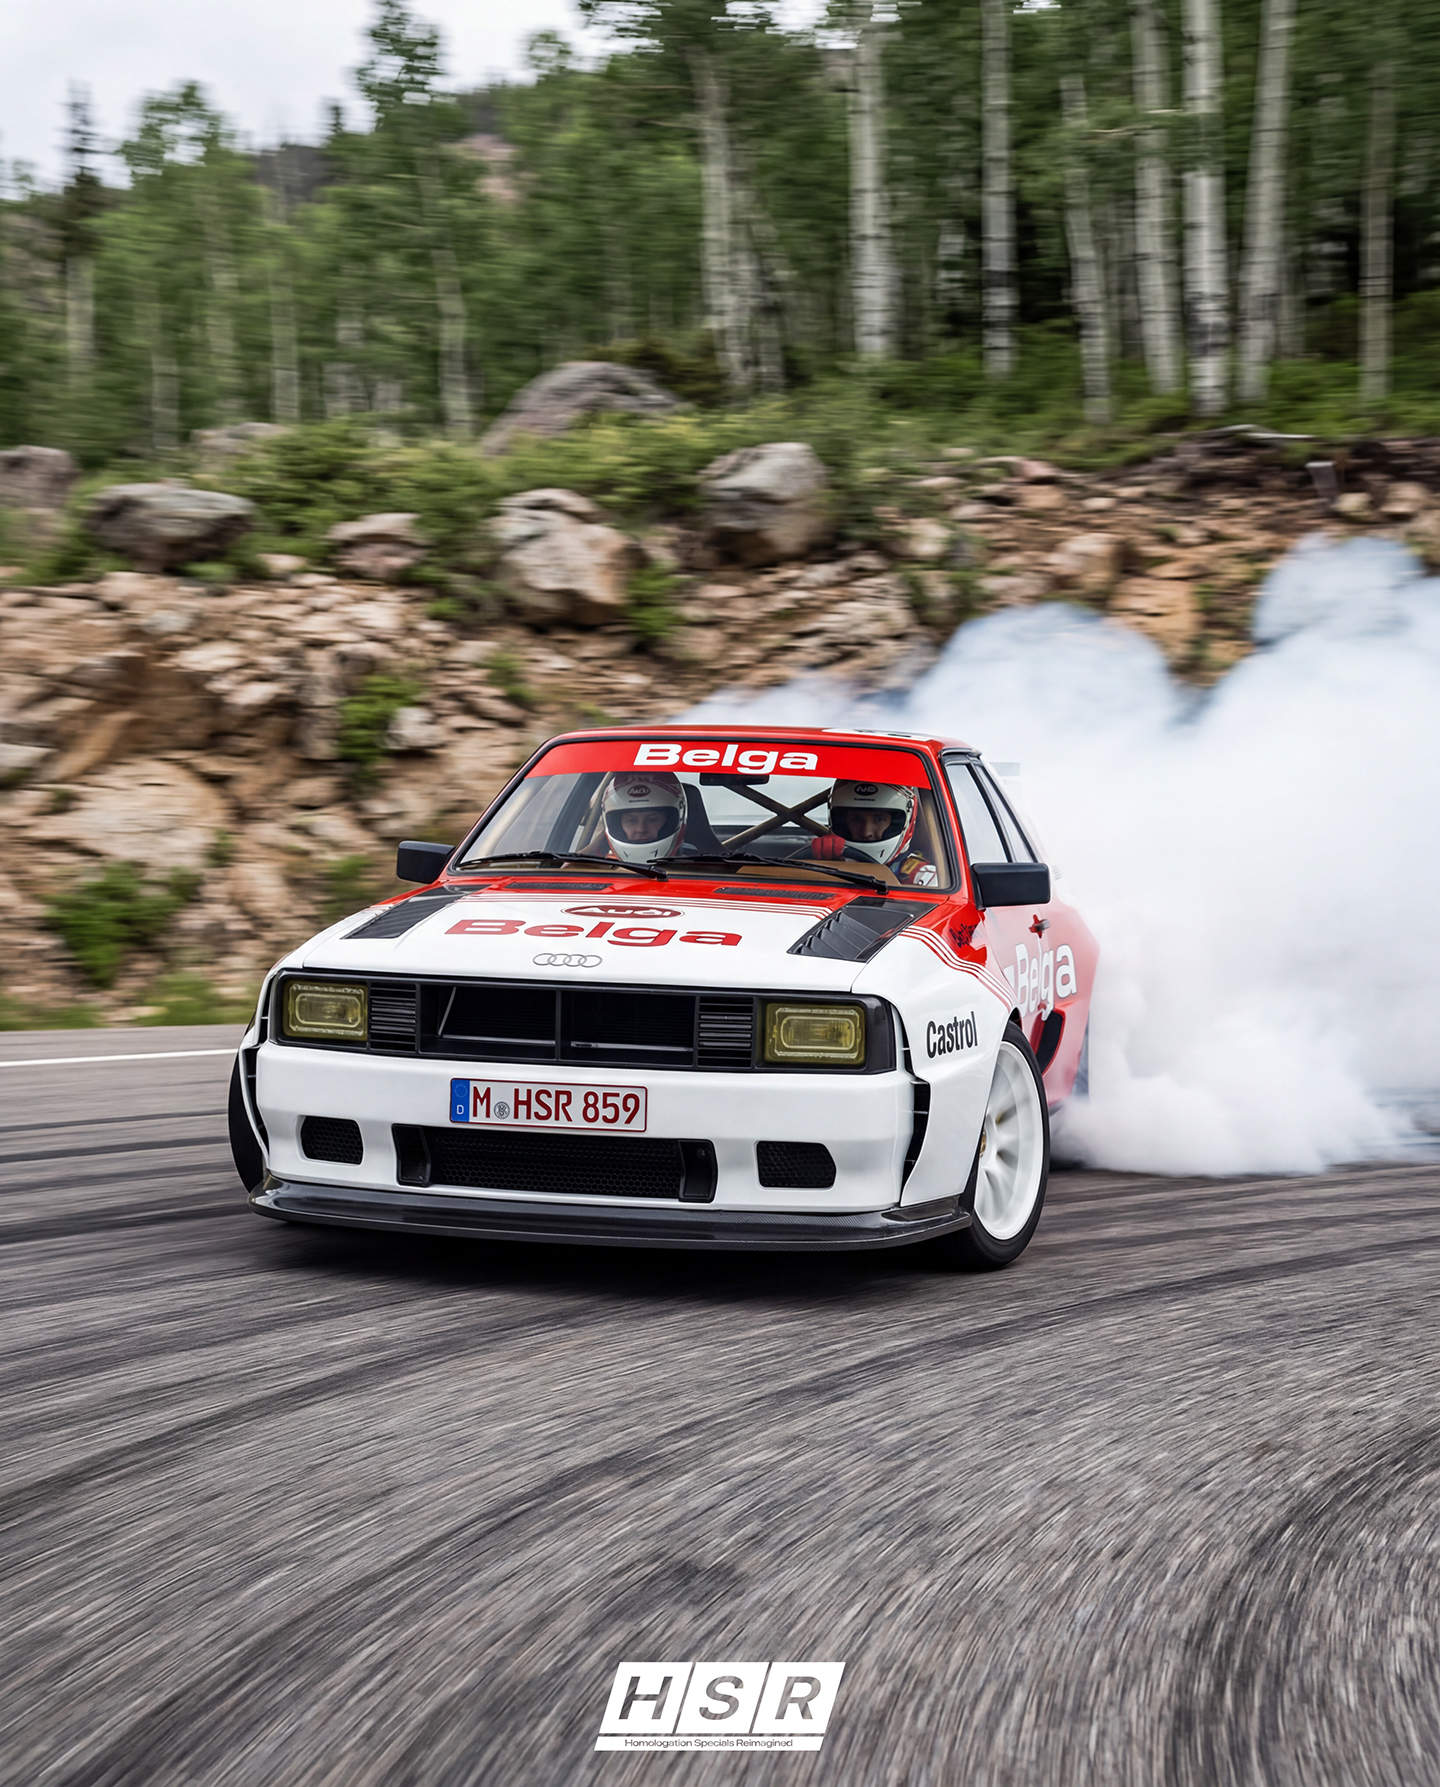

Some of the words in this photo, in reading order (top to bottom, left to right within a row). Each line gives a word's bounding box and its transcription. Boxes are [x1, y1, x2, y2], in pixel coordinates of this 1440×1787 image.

[633, 743, 819, 775] Belga
[444, 919, 743, 947] Belga
[1015, 943, 1077, 1022] Belga
[926, 1010, 979, 1059] Castrol
[472, 1086, 491, 1118] M
[513, 1087, 573, 1122] HSR
[582, 1090, 640, 1125] 859
